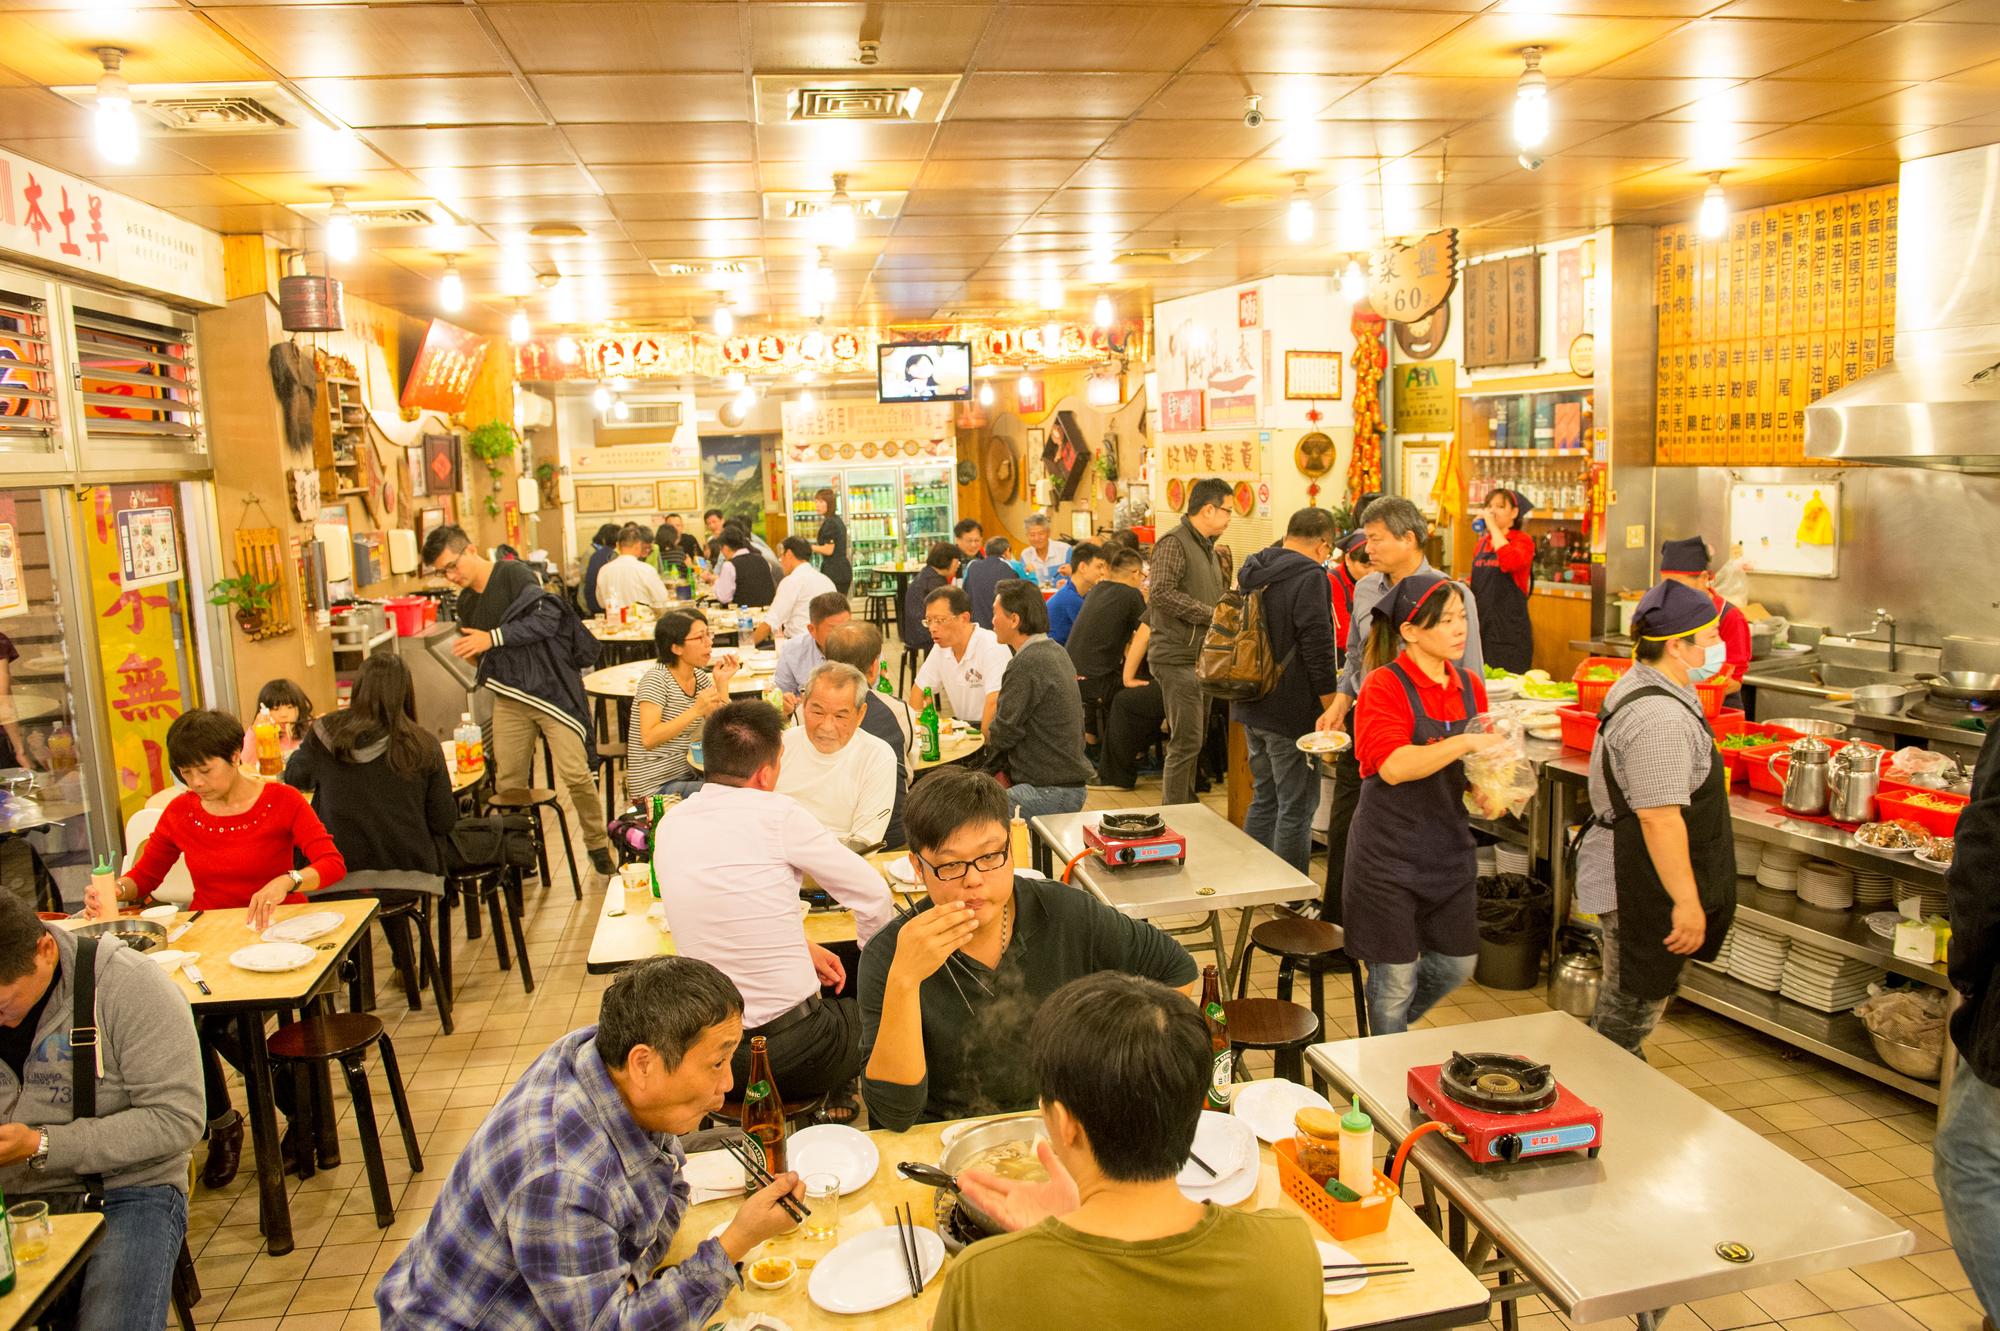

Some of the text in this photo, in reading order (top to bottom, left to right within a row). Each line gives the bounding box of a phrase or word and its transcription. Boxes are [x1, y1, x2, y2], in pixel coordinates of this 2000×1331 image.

[1813, 209, 1828, 297] 炒麻油羊肉
[1865, 200, 1881, 291] 炒麻油羊心
[1394, 287, 1421, 312] 60
[1777, 346, 1791, 429] 羊尾巴
[49, 1086, 72, 1103] 73
[1721, 1244, 1747, 1259] 19
